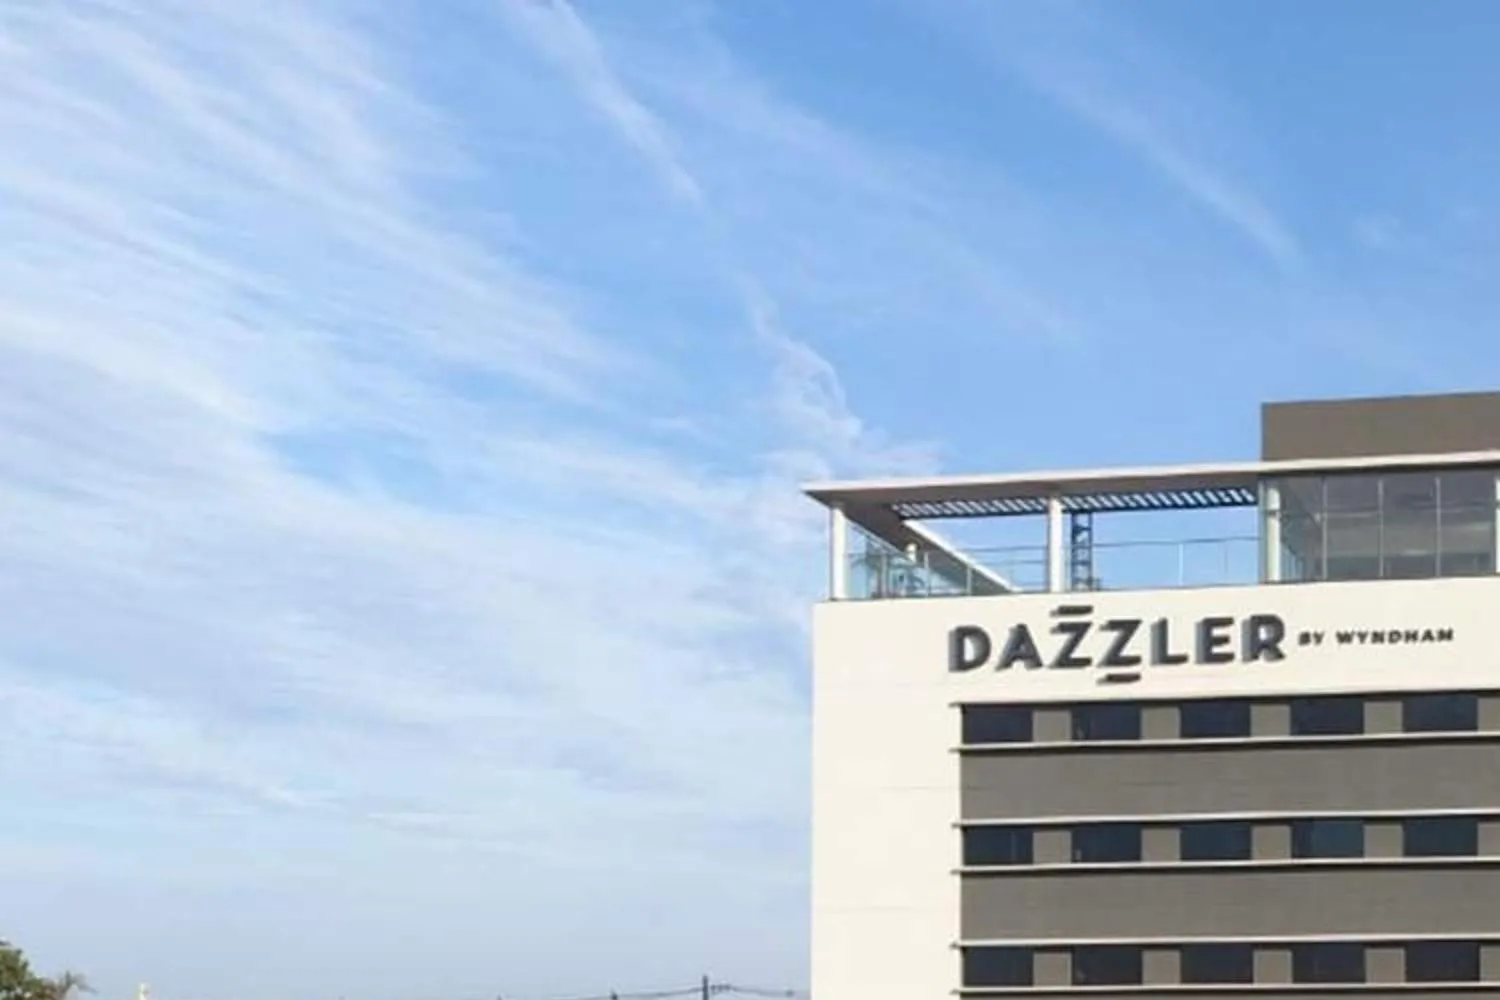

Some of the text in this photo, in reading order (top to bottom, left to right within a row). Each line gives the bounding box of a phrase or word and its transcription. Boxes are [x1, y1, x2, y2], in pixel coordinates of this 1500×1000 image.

[948, 605, 1455, 684] DAZZLER BY WYNDHAM
